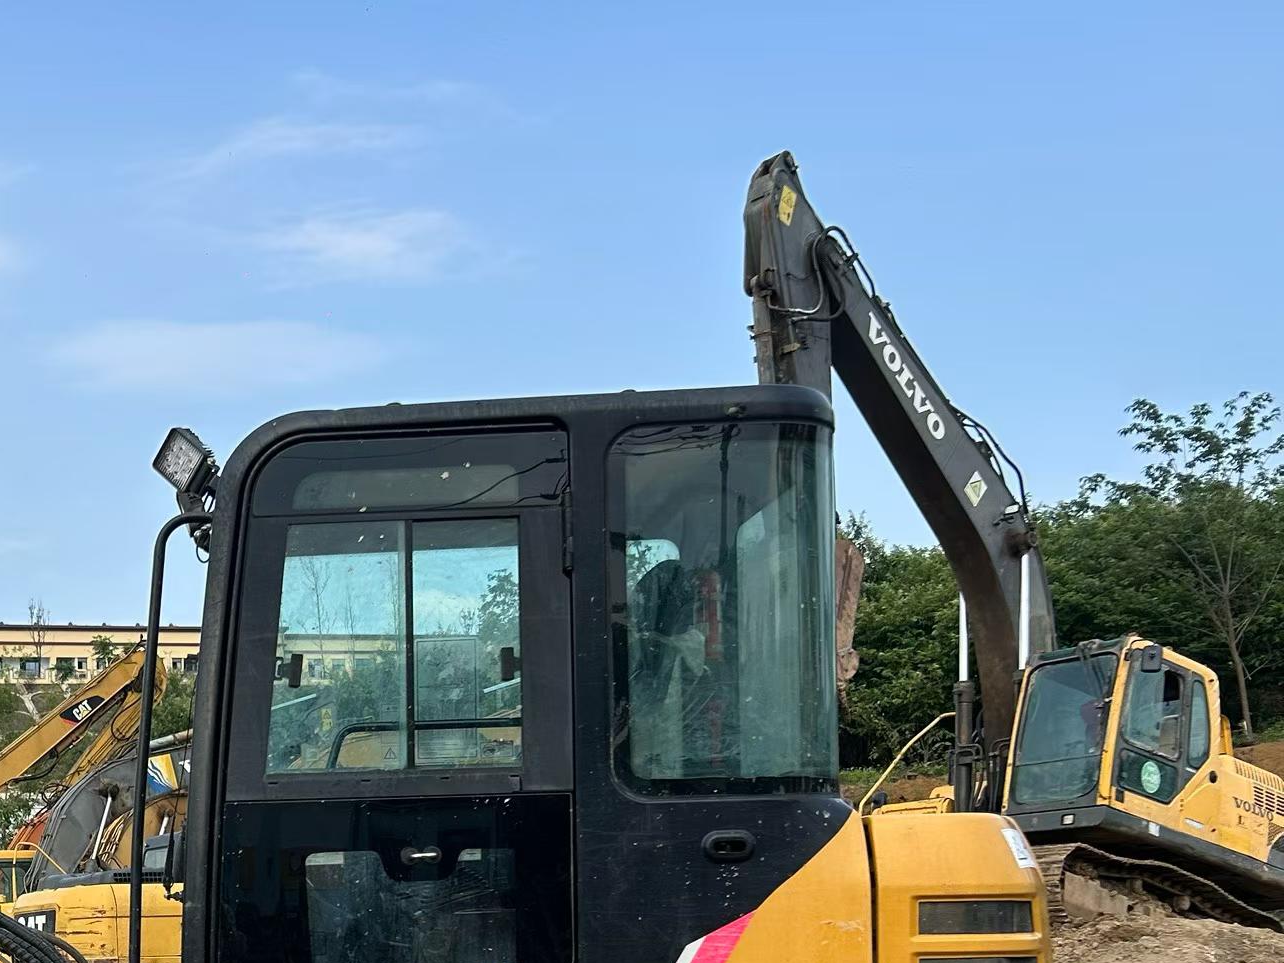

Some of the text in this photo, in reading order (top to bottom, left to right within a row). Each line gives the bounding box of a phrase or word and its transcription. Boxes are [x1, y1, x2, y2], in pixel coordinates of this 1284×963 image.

[868, 311, 946, 440] VOLVO
[72, 699, 93, 721] CAT
[1232, 795, 1274, 822] VOLVO
